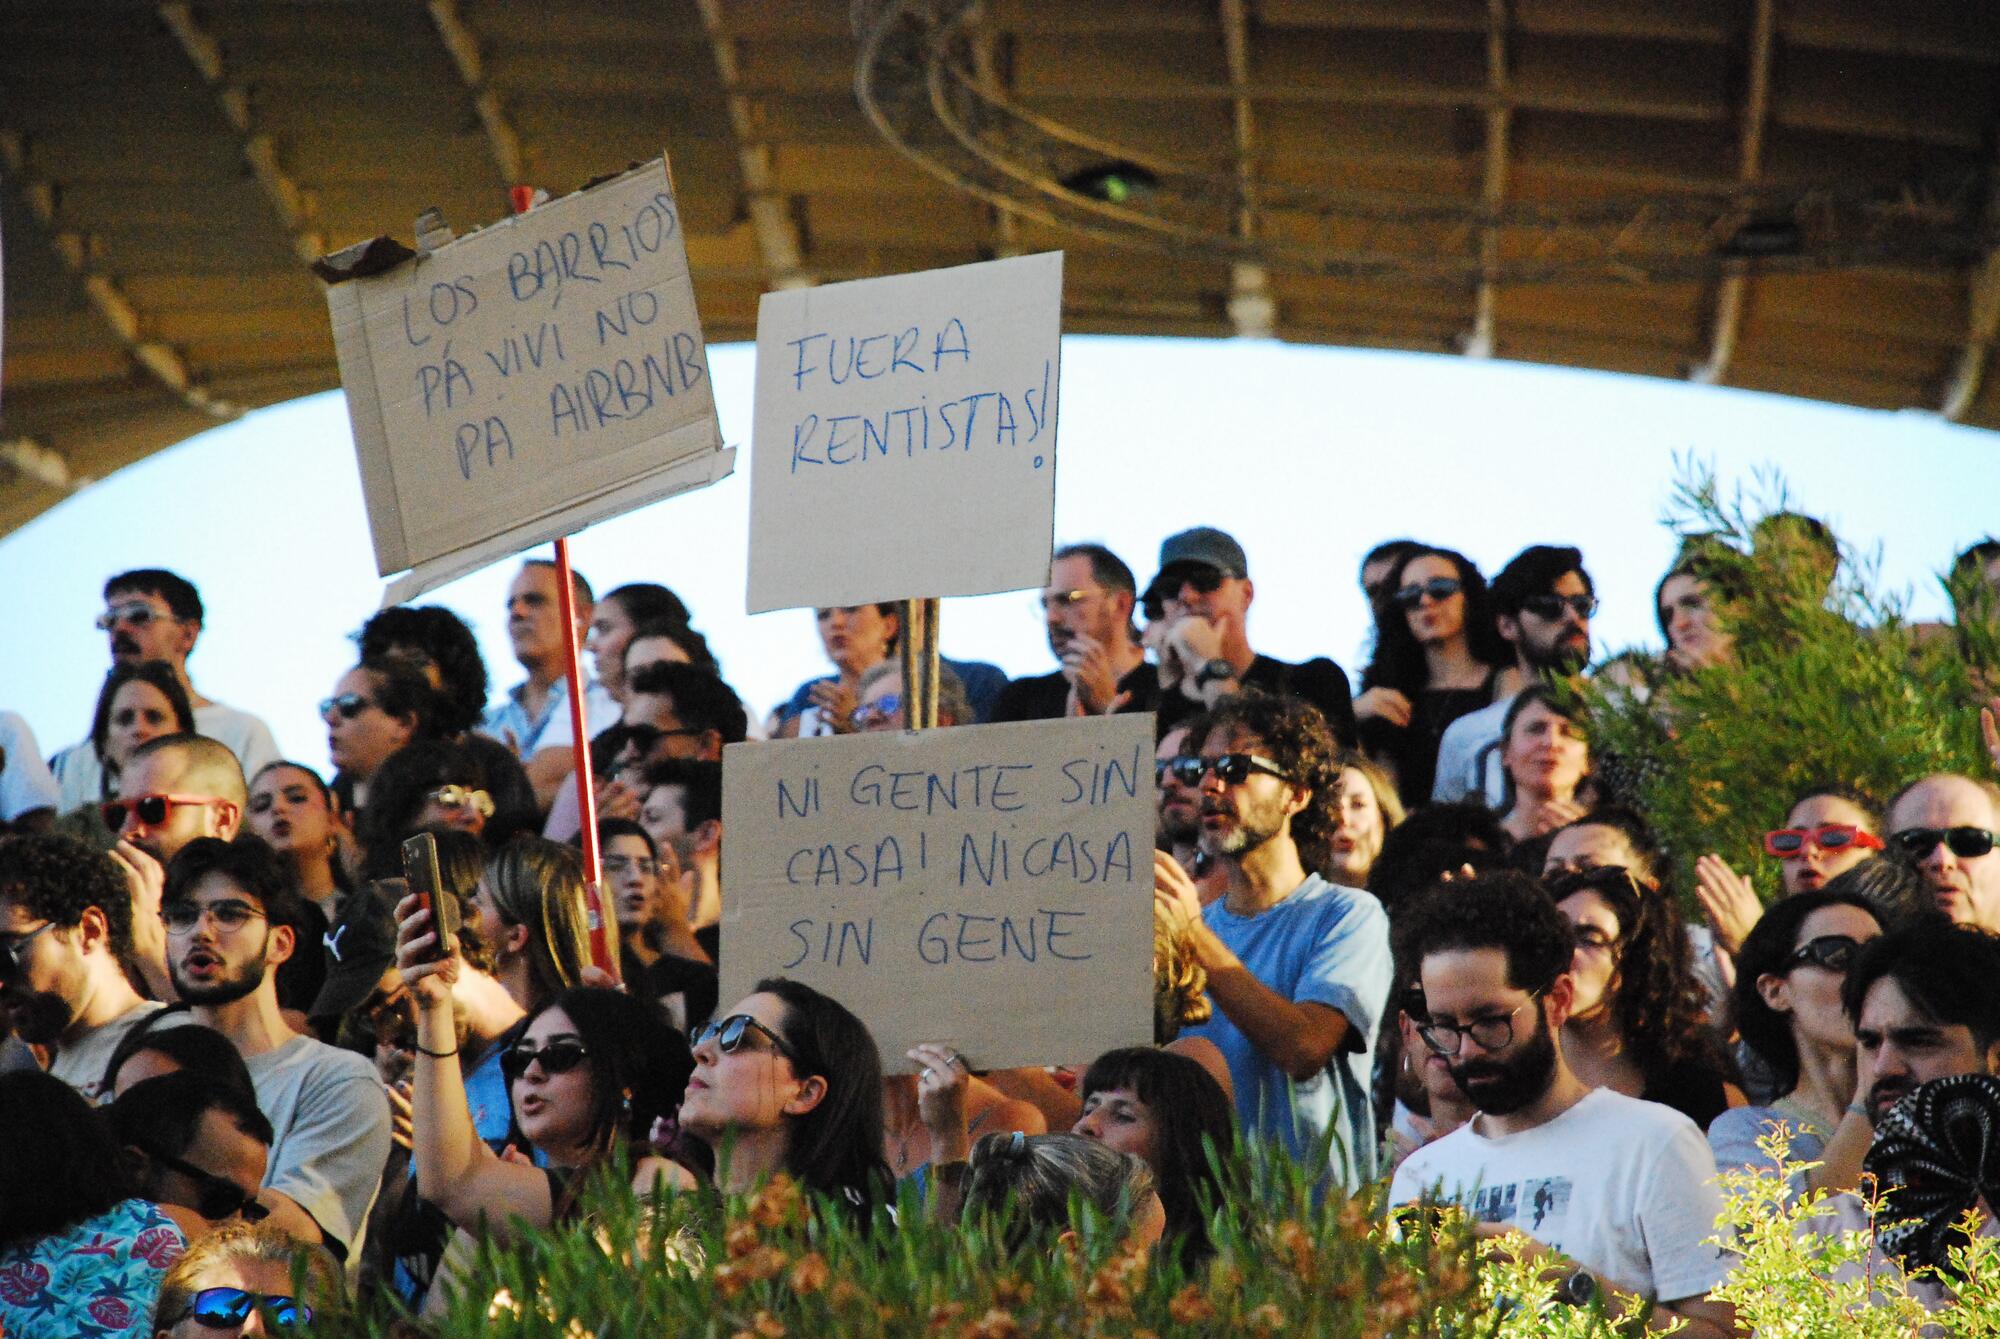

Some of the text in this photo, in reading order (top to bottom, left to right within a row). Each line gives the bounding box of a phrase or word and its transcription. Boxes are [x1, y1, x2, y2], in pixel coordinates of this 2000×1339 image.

[404, 193, 675, 346] LOS BARRIOS
[596, 291, 658, 345] NO
[787, 317, 971, 391] FUERA
[550, 332, 704, 437] AIRBNB
[790, 360, 1049, 475] RENTISTAS!
[849, 764, 1034, 816] GENTE
[917, 907, 1092, 966] GENE
